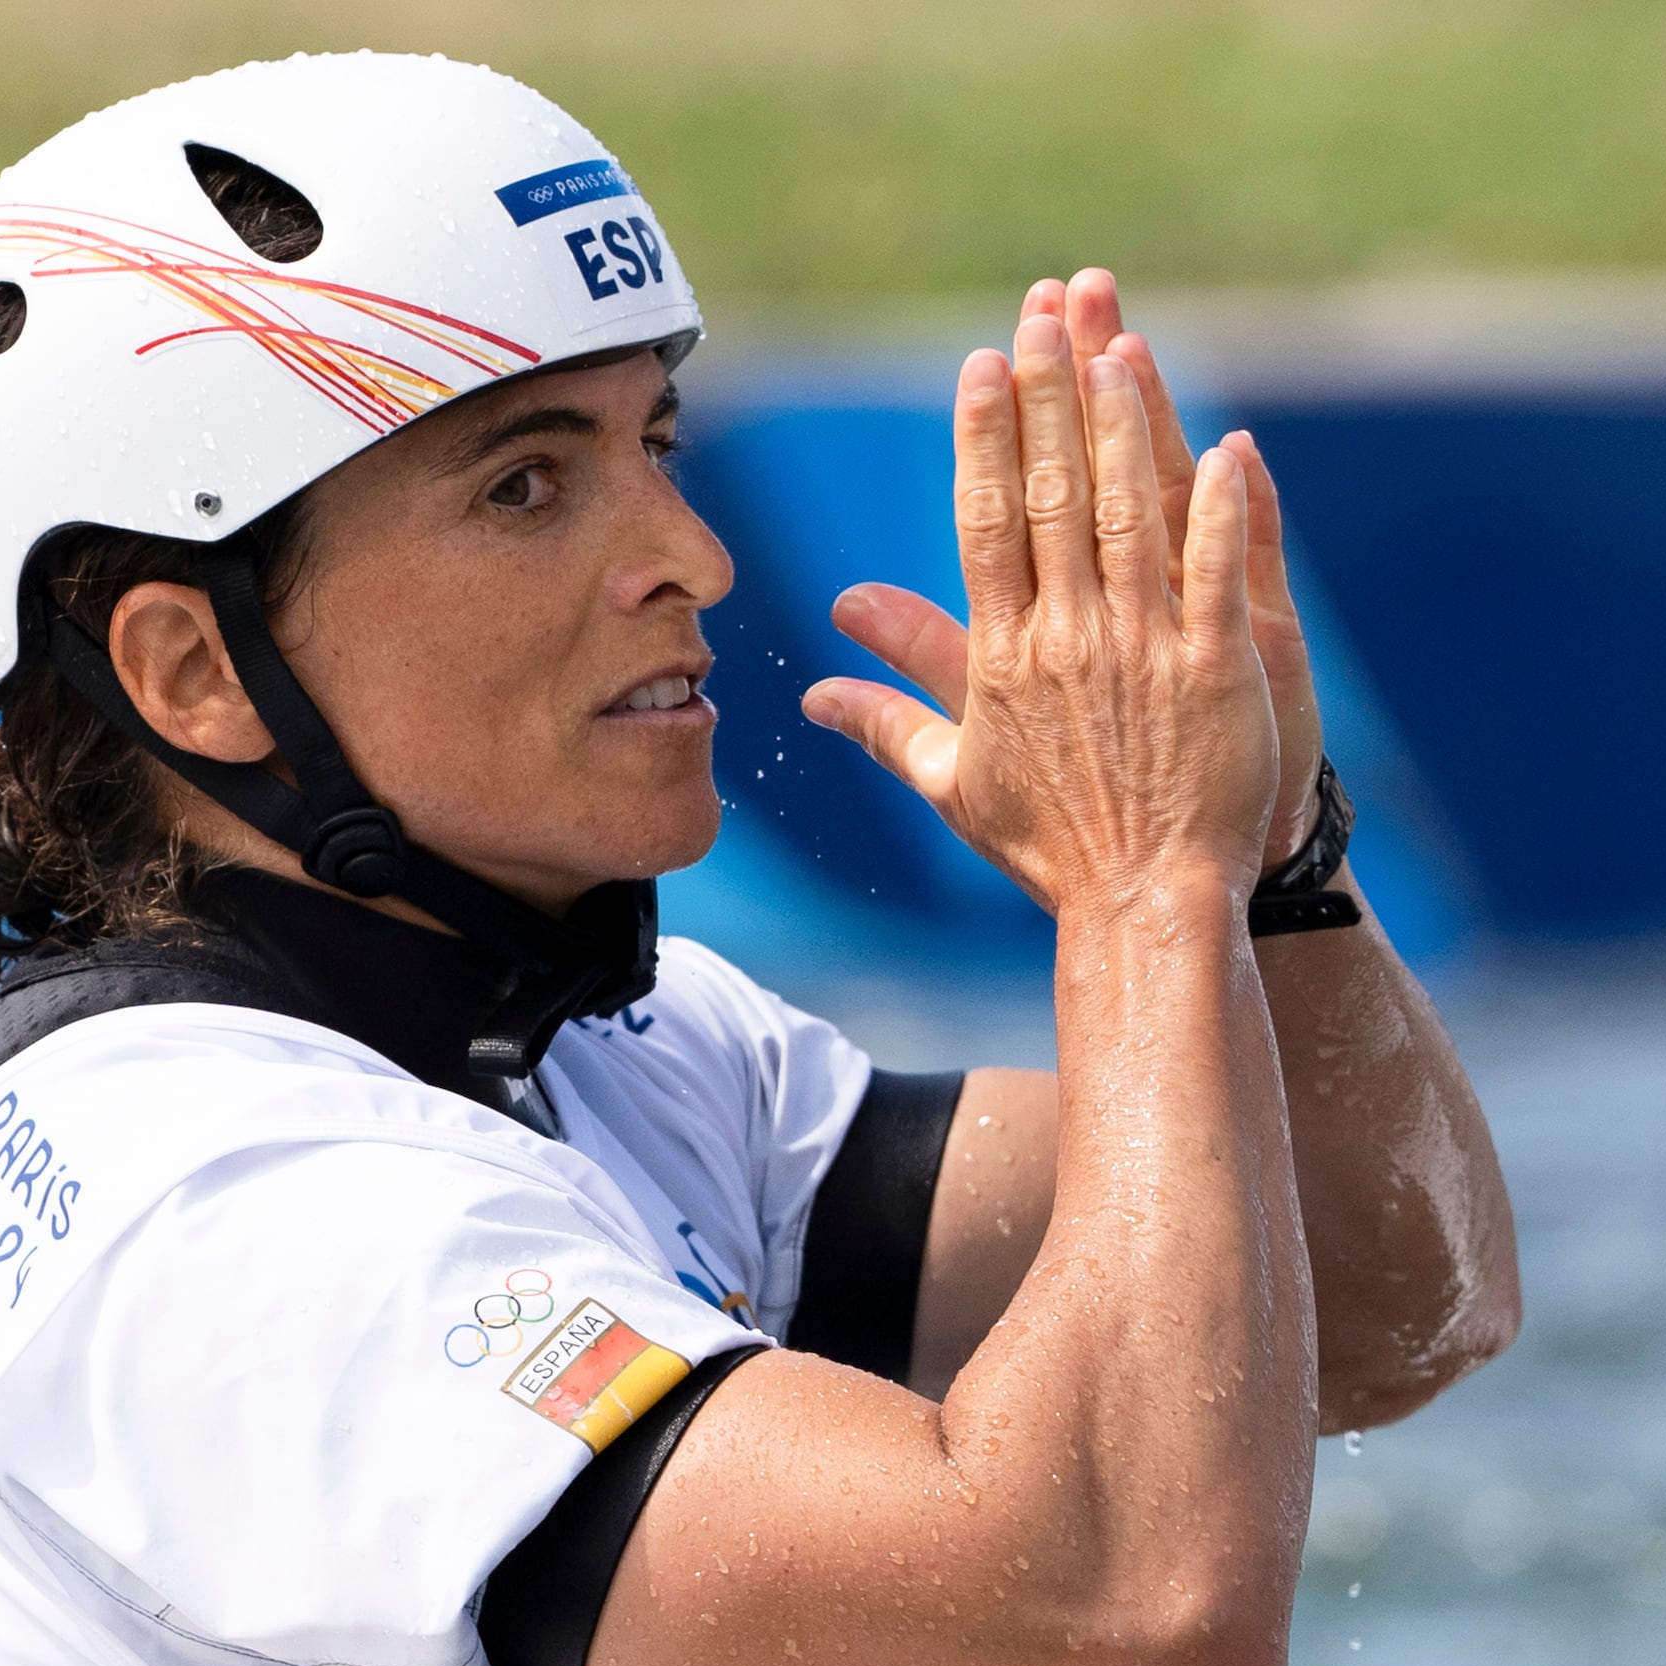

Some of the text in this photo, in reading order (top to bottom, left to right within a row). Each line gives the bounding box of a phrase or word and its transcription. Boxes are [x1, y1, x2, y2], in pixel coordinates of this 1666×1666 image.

[555, 173, 599, 196] PARIS
[564, 216, 664, 301] ESP
[519, 1313, 606, 1395] ESPAÑA
